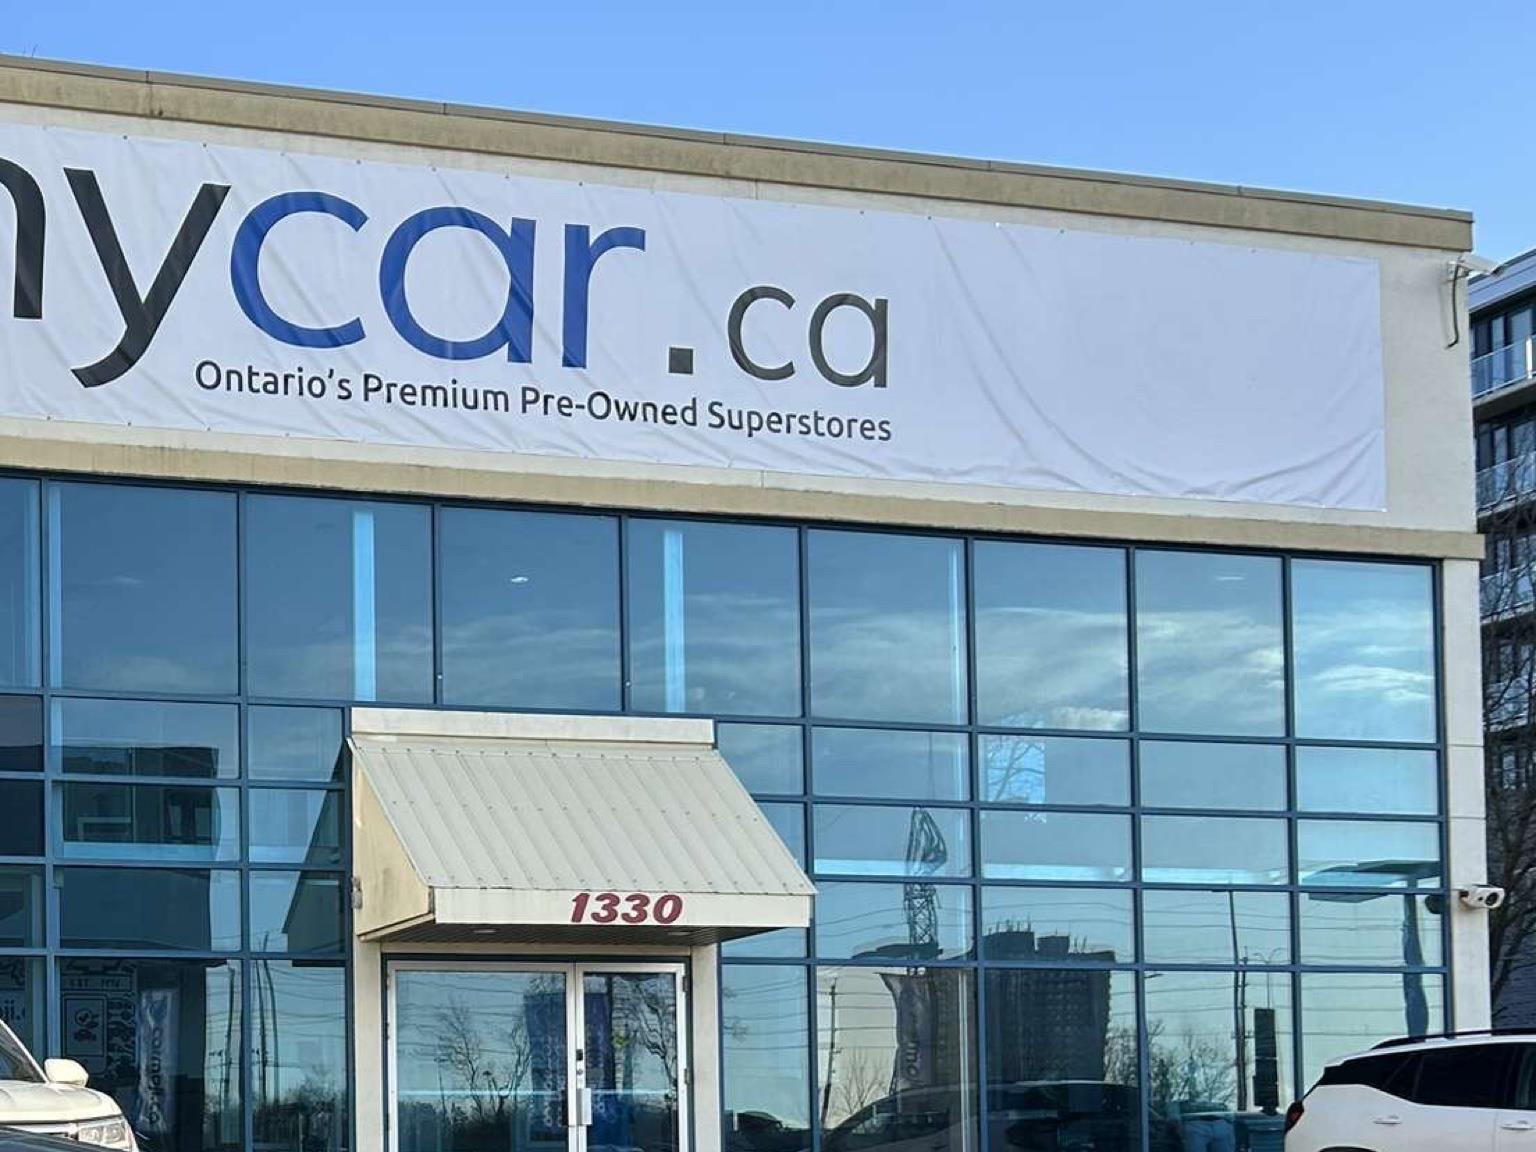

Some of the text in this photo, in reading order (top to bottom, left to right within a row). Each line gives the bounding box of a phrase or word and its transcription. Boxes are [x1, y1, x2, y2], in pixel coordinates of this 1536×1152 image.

[195, 360, 893, 442] Ontario's Premium Pre-Owned Superstores
[571, 892, 684, 924] 1330
